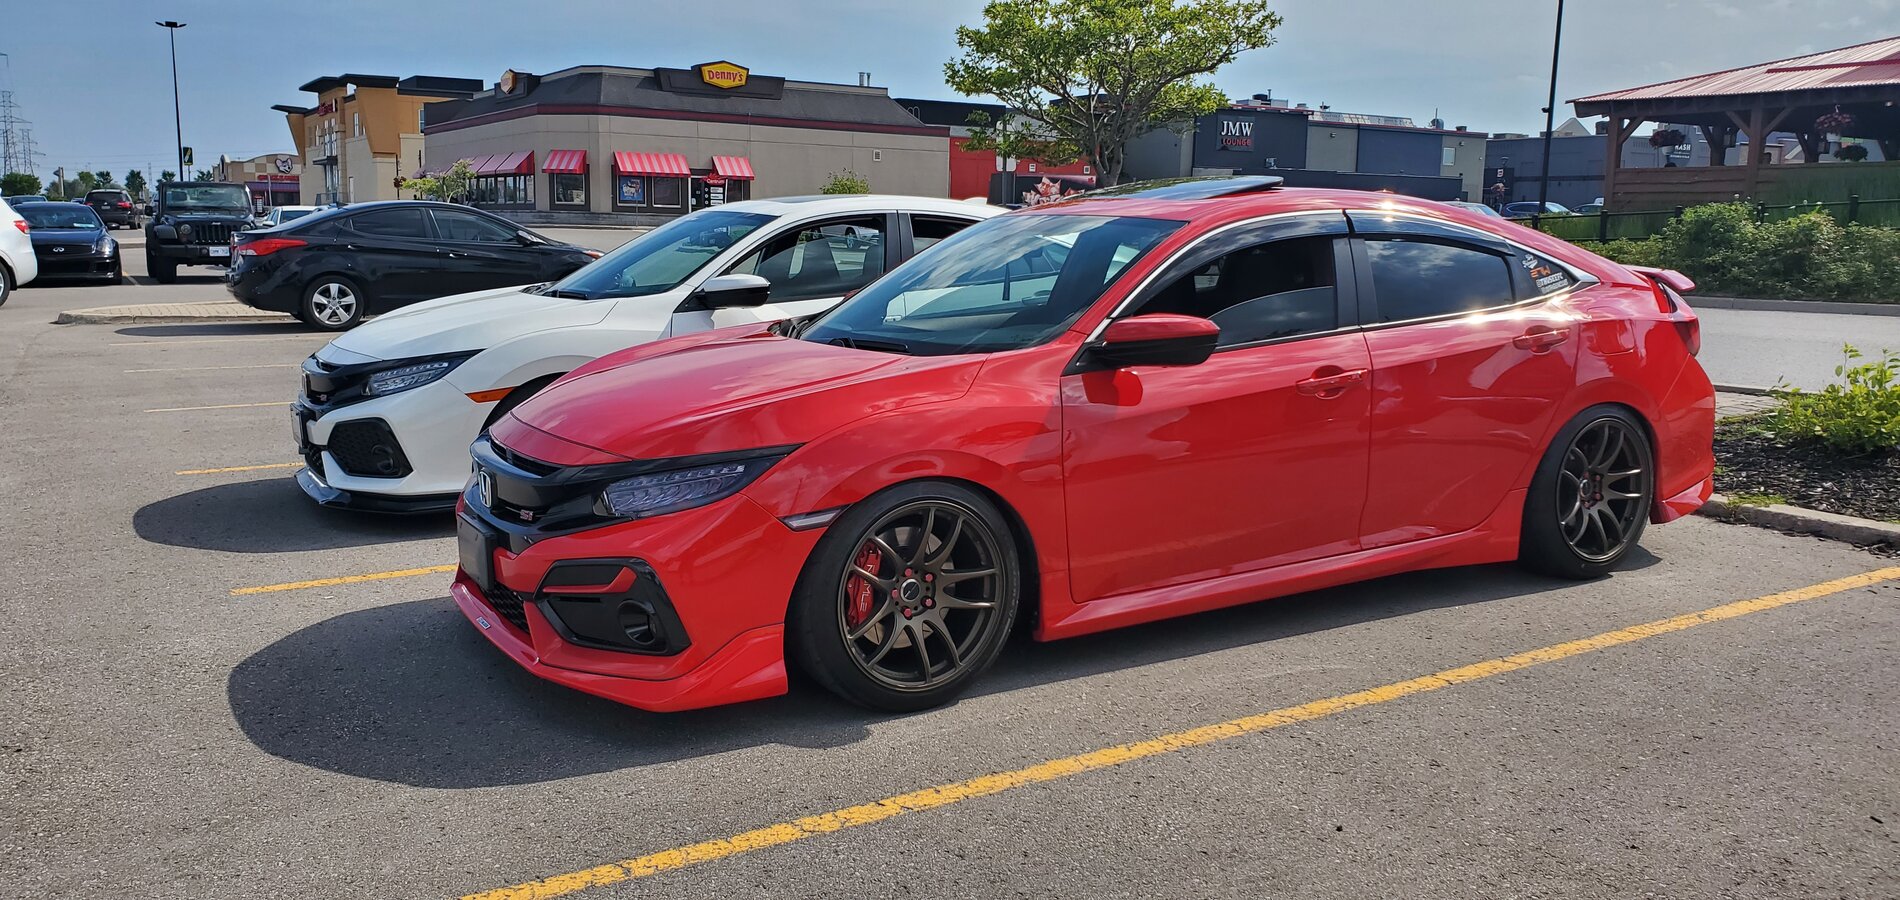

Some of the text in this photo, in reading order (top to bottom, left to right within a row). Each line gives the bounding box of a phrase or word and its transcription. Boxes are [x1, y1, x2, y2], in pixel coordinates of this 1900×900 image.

[707, 69, 744, 83] Denny's
[1221, 120, 1254, 137] JMW
[1222, 138, 1252, 146] LOUNGE
